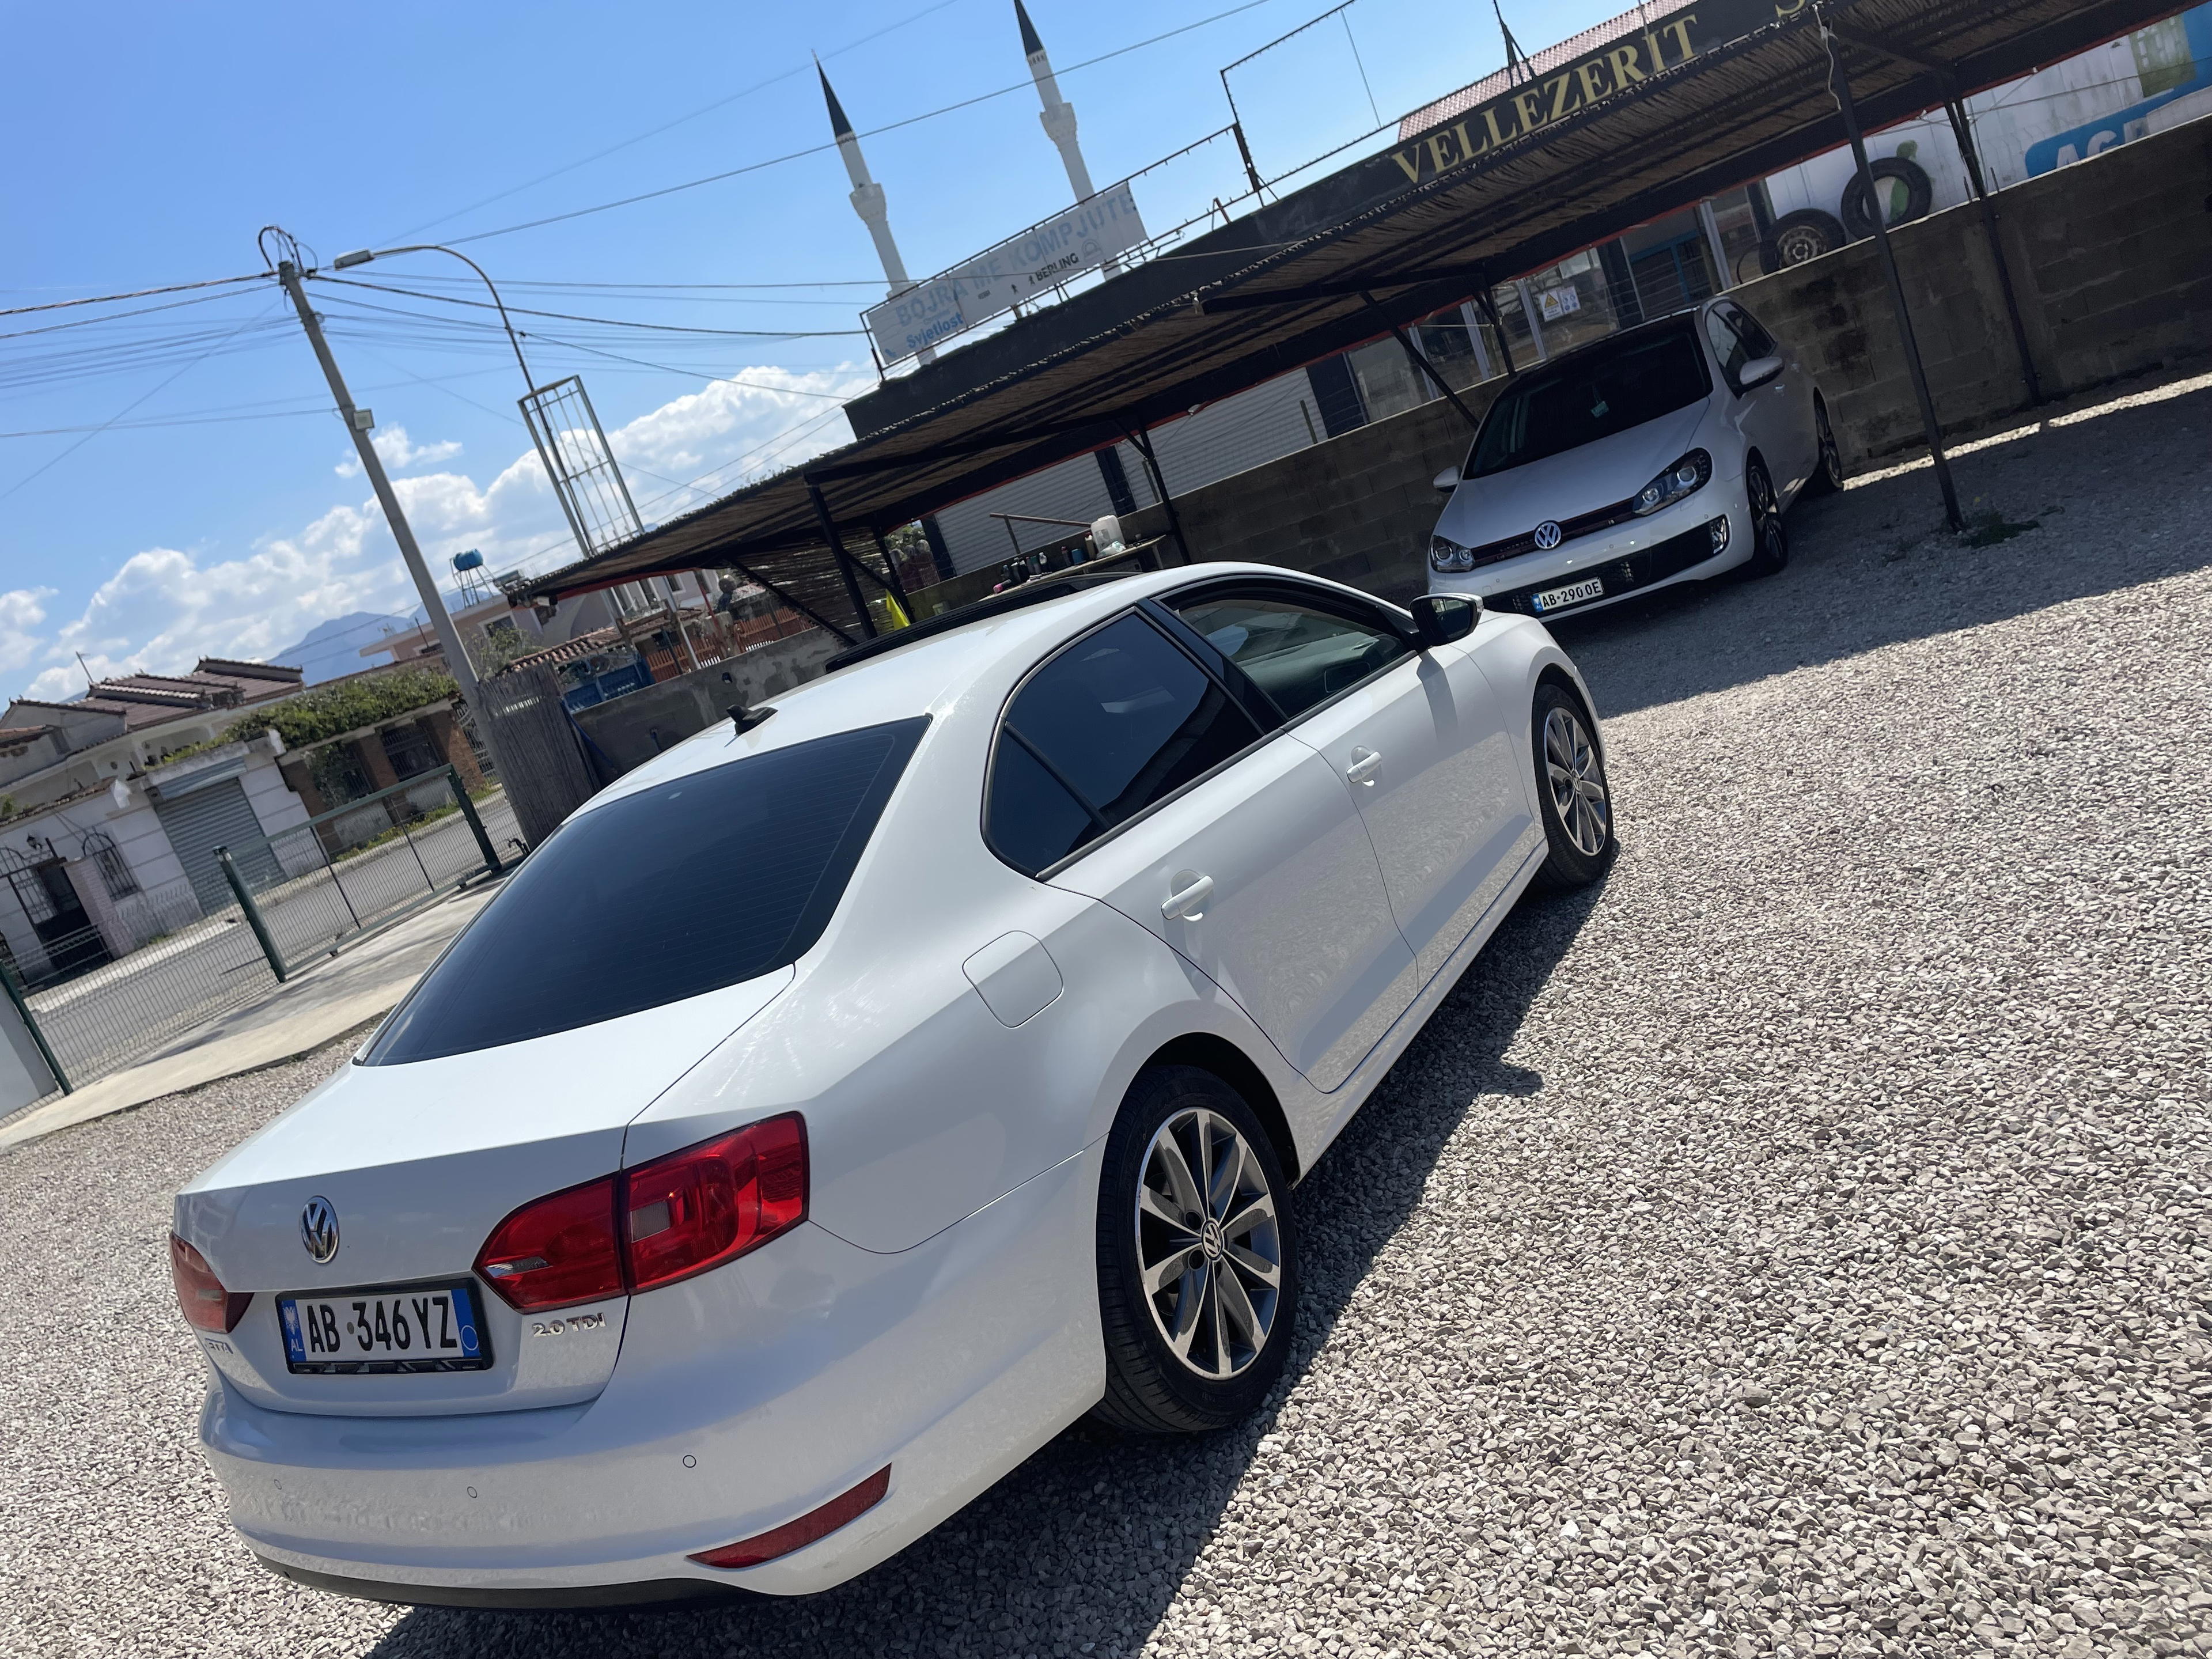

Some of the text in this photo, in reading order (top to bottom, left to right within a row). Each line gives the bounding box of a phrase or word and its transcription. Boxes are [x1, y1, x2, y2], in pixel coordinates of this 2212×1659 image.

[1391, 13, 1699, 184] VELLEZERIT
[896, 192, 1135, 327] BOJRA ME KOMPJUTE
[1036, 252, 1080, 281] BERLING
[906, 312, 964, 349] Svjetlost
[1542, 594, 1556, 607] AB
[307, 1305, 340, 1353] AB
[566, 1312, 606, 1332] TDI
[291, 1338, 304, 1352] AL
